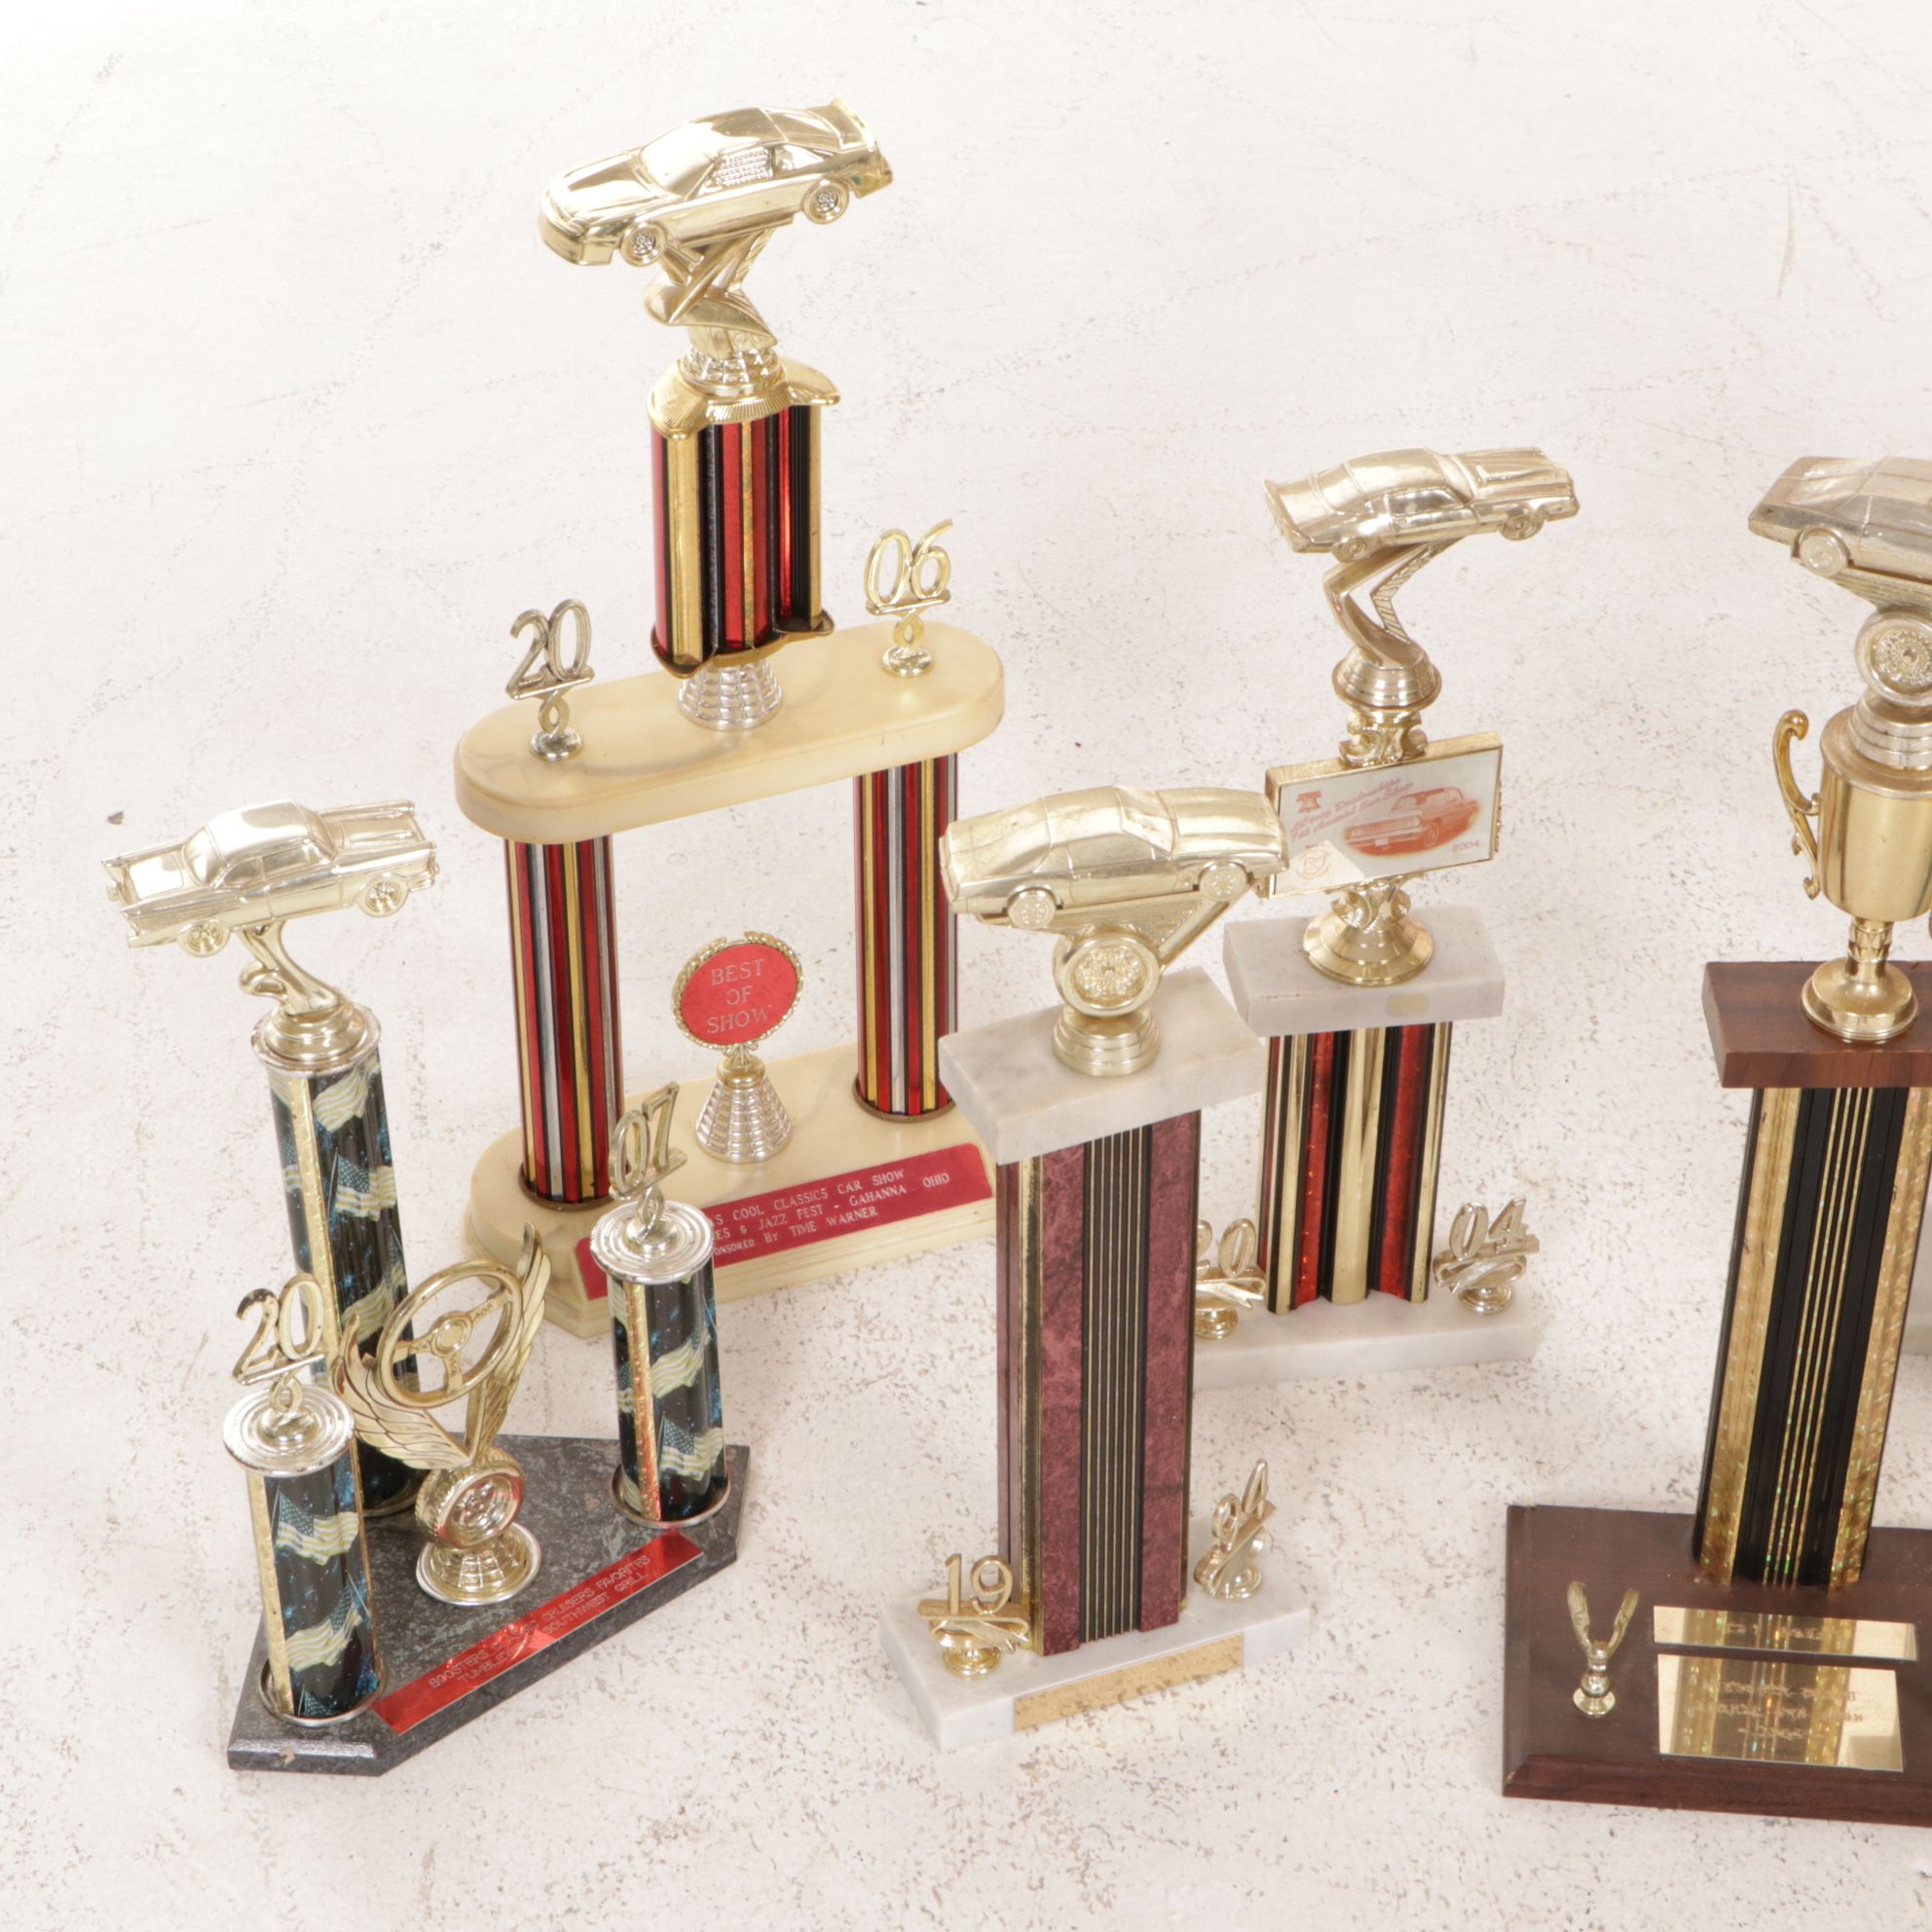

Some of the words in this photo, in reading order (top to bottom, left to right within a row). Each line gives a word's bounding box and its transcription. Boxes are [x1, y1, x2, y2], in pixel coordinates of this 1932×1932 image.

[864, 519, 953, 607] 06
[505, 598, 592, 691] 20
[711, 959, 763, 985] BEST
[725, 985, 753, 1005] OF
[609, 1081, 680, 1196] 07
[732, 1205, 764, 1221] COOL
[773, 1188, 829, 1210] CLASSICS
[837, 1179, 863, 1195] CAR
[872, 1169, 905, 1186] SHOW
[759, 1213, 788, 1231] JAZZ
[796, 1204, 824, 1220] FEST
[849, 1184, 908, 1207] GAHANNA
[922, 1172, 950, 1188] OHIO
[714, 1239, 756, 1256] ONSORED
[789, 1220, 817, 1238] TIME
[826, 1206, 878, 1227] WARNER
[1448, 1197, 1530, 1260] 04
[232, 1272, 325, 1384] 20
[542, 1591, 611, 1635] SOUTHWEST
[614, 1572, 650, 1593] GRILL
[944, 1553, 1014, 1616] 19
[428, 1650, 489, 1689] BOOSTERS
[541, 1587, 595, 1621] CRUISERS
[596, 1554, 651, 1589] FAVORITES
